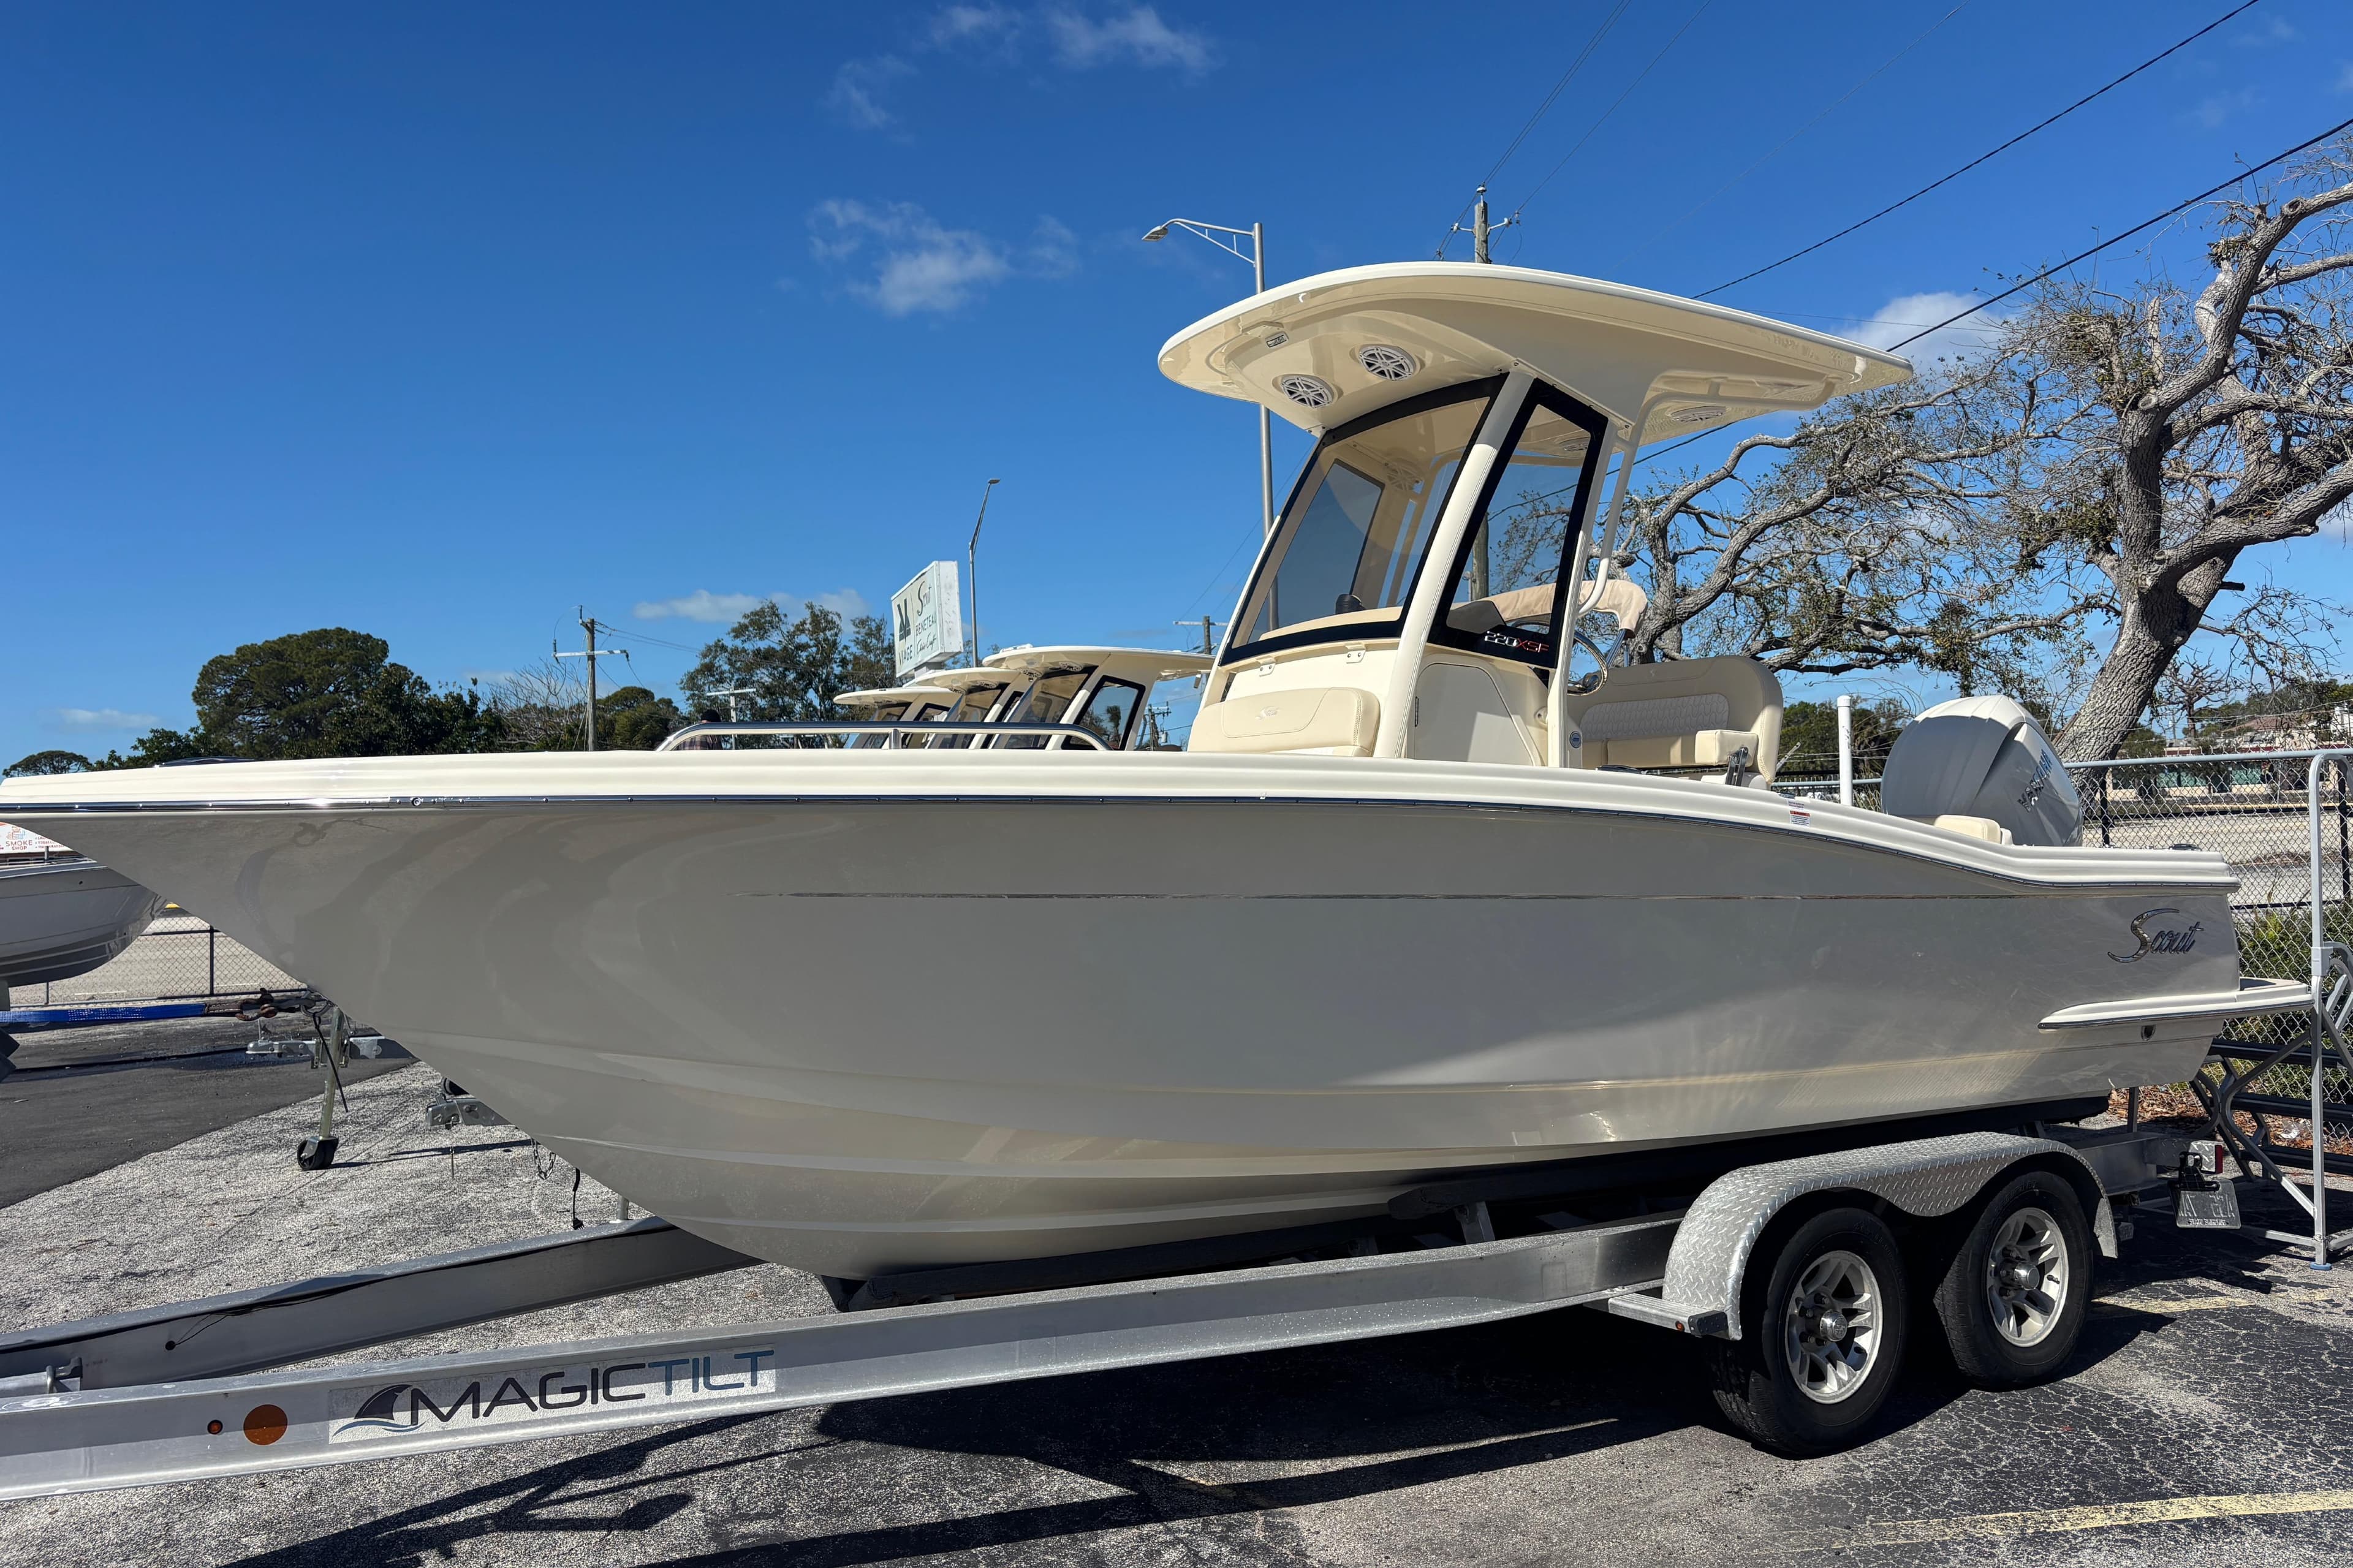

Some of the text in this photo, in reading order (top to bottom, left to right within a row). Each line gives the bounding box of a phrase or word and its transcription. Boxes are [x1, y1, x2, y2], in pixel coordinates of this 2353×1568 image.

[916, 613, 937, 637] BENETEAU
[1484, 631, 1550, 653] 220XSF
[898, 645, 912, 665] VIAGE
[2107, 908, 2205, 963] Scout
[410, 1349, 775, 1426] MAGICTILT
